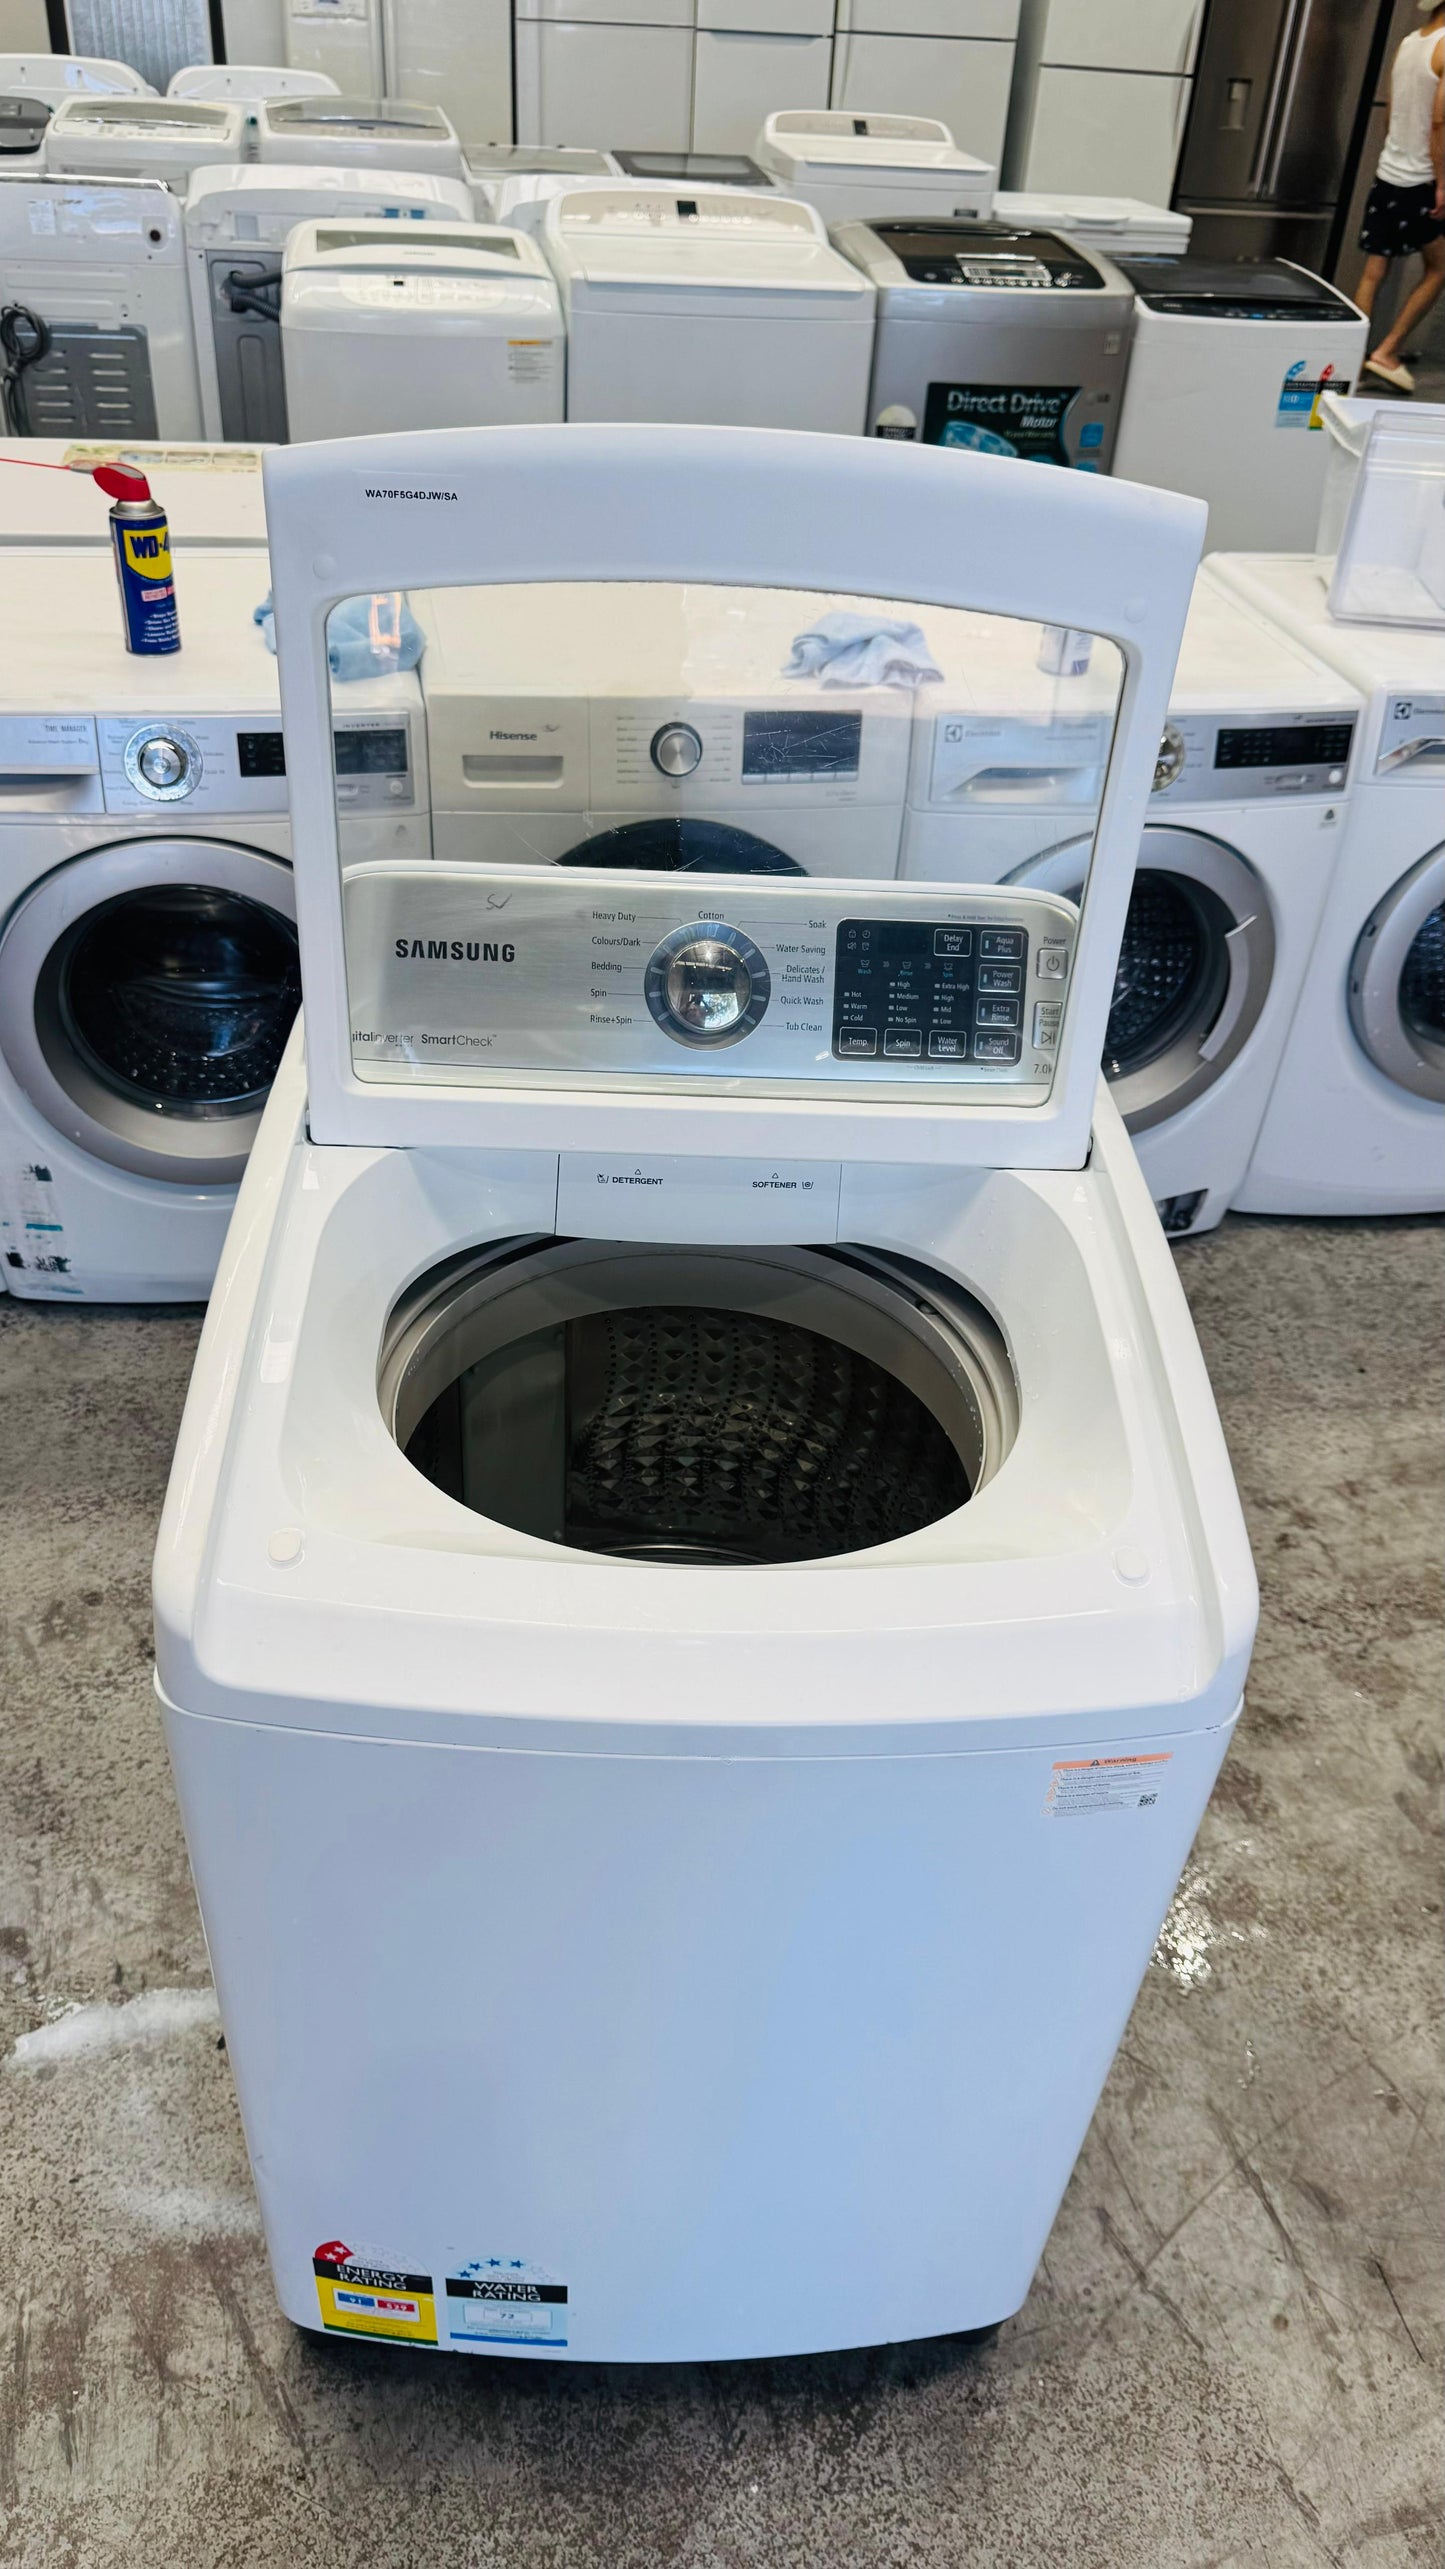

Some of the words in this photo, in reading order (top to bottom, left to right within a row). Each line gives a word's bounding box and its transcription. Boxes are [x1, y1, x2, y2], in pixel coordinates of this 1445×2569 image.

[947, 391, 1006, 413] Direct
[1020, 416, 1057, 428] Motor
[365, 489, 458, 501] WA70F5G4DJW/SA
[490, 730, 537, 741] Hisense
[592, 911, 616, 922] Heavy
[617, 912, 636, 923] Duty
[698, 911, 725, 920] Cotton
[808, 920, 827, 929] Soak
[591, 936, 641, 947] Colours/Dark
[943, 934, 964, 944] Delay
[995, 936, 1014, 946] Aqua
[1043, 936, 1067, 946] Power
[395, 938, 516, 963] SAMSUNG
[776, 944, 799, 954] Water
[801, 945, 826, 955] Saving
[947, 943, 961, 951] End
[997, 945, 1012, 954] Plus
[591, 962, 622, 973] Bedding
[786, 965, 819, 974] Delicates
[781, 974, 800, 984] Hand
[803, 974, 825, 984] Wash
[992, 970, 1014, 979] Power
[897, 981, 911, 989] High
[956, 983, 970, 991] High
[993, 978, 1012, 988] Wash
[590, 989, 607, 999] Spin
[941, 994, 955, 1002] High
[780, 996, 801, 1006] Quick
[803, 997, 824, 1006] Wash
[992, 1005, 1010, 1013] Extra
[1041, 1006, 1059, 1016] Start
[590, 1014, 632, 1026] Rinse+Spin
[850, 1014, 864, 1022] Cold
[905, 1016, 917, 1024] Spin
[991, 1013, 1010, 1022] Rinse
[786, 1022, 799, 1031] Tub
[801, 1023, 823, 1032] Clean
[848, 1037, 869, 1047] Temp.
[895, 1039, 911, 1048] Spin
[938, 1036, 958, 1046] Water
[988, 1038, 1010, 1046] Sound
[938, 1045, 957, 1053] Level
[992, 1046, 1004, 1055] Off
[612, 1176, 664, 1186] DETERGENT
[752, 1181, 797, 1189] SOFTENER
[337, 2264, 407, 2282] ENERGY
[340, 2273, 407, 2290] RATING
[475, 2282, 538, 2294] WATER
[473, 2290, 541, 2302] RATING
